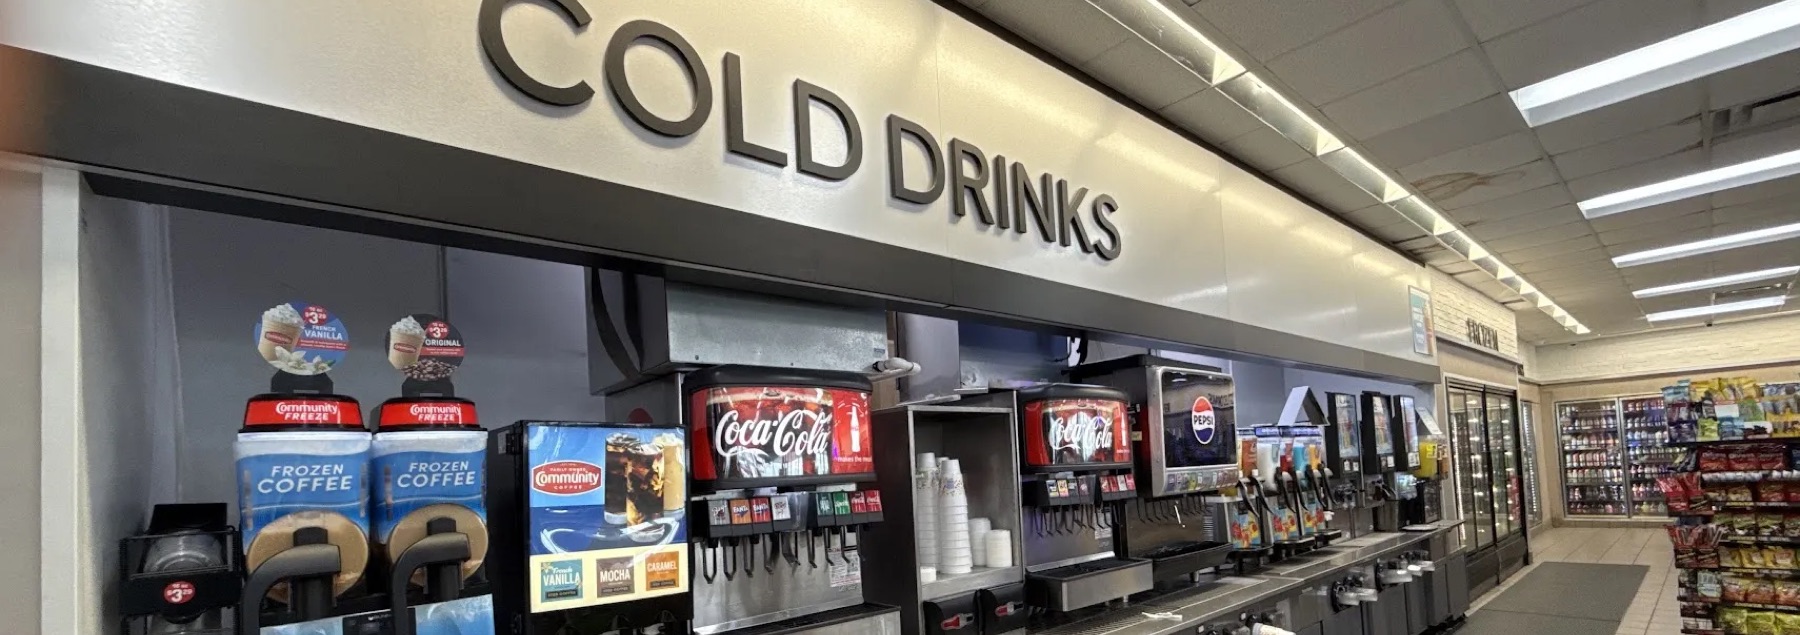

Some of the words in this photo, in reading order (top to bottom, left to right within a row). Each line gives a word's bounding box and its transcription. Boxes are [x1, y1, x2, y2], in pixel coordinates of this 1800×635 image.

[478, 0, 863, 181] COLD
[886, 114, 1122, 261] DRINKS
[304, 330, 343, 341] VANILLA
[425, 339, 461, 347] ORIGINAL
[276, 402, 338, 414] Community
[410, 403, 461, 415] Community
[284, 412, 329, 421] FREEZE
[418, 414, 455, 422] FREEZE
[1193, 414, 1214, 425] PEPSI
[271, 464, 344, 478] FROZEN
[408, 461, 469, 473] FROZEN
[397, 471, 475, 488] COFFEE
[535, 470, 599, 486] Community
[257, 475, 353, 494] COFFEE
[552, 566, 573, 574] French
[647, 561, 678, 572] CARAMEL
[543, 571, 580, 586] VANILLA
[600, 568, 631, 583] MOCHA
